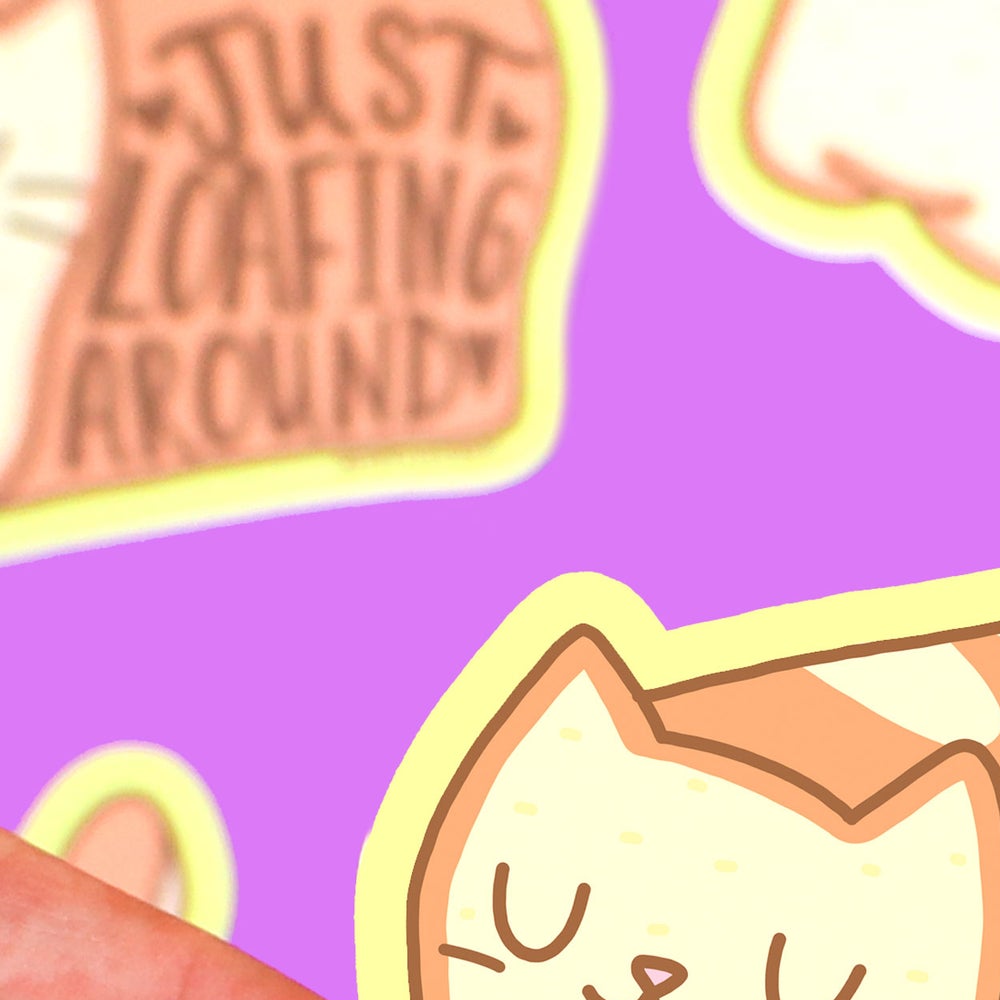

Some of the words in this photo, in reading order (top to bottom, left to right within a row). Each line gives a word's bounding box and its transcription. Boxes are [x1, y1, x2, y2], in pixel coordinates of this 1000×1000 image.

[152, 8, 552, 158] JUST
[88, 155, 532, 320] LOAFING
[61, 313, 462, 468] AROUND
